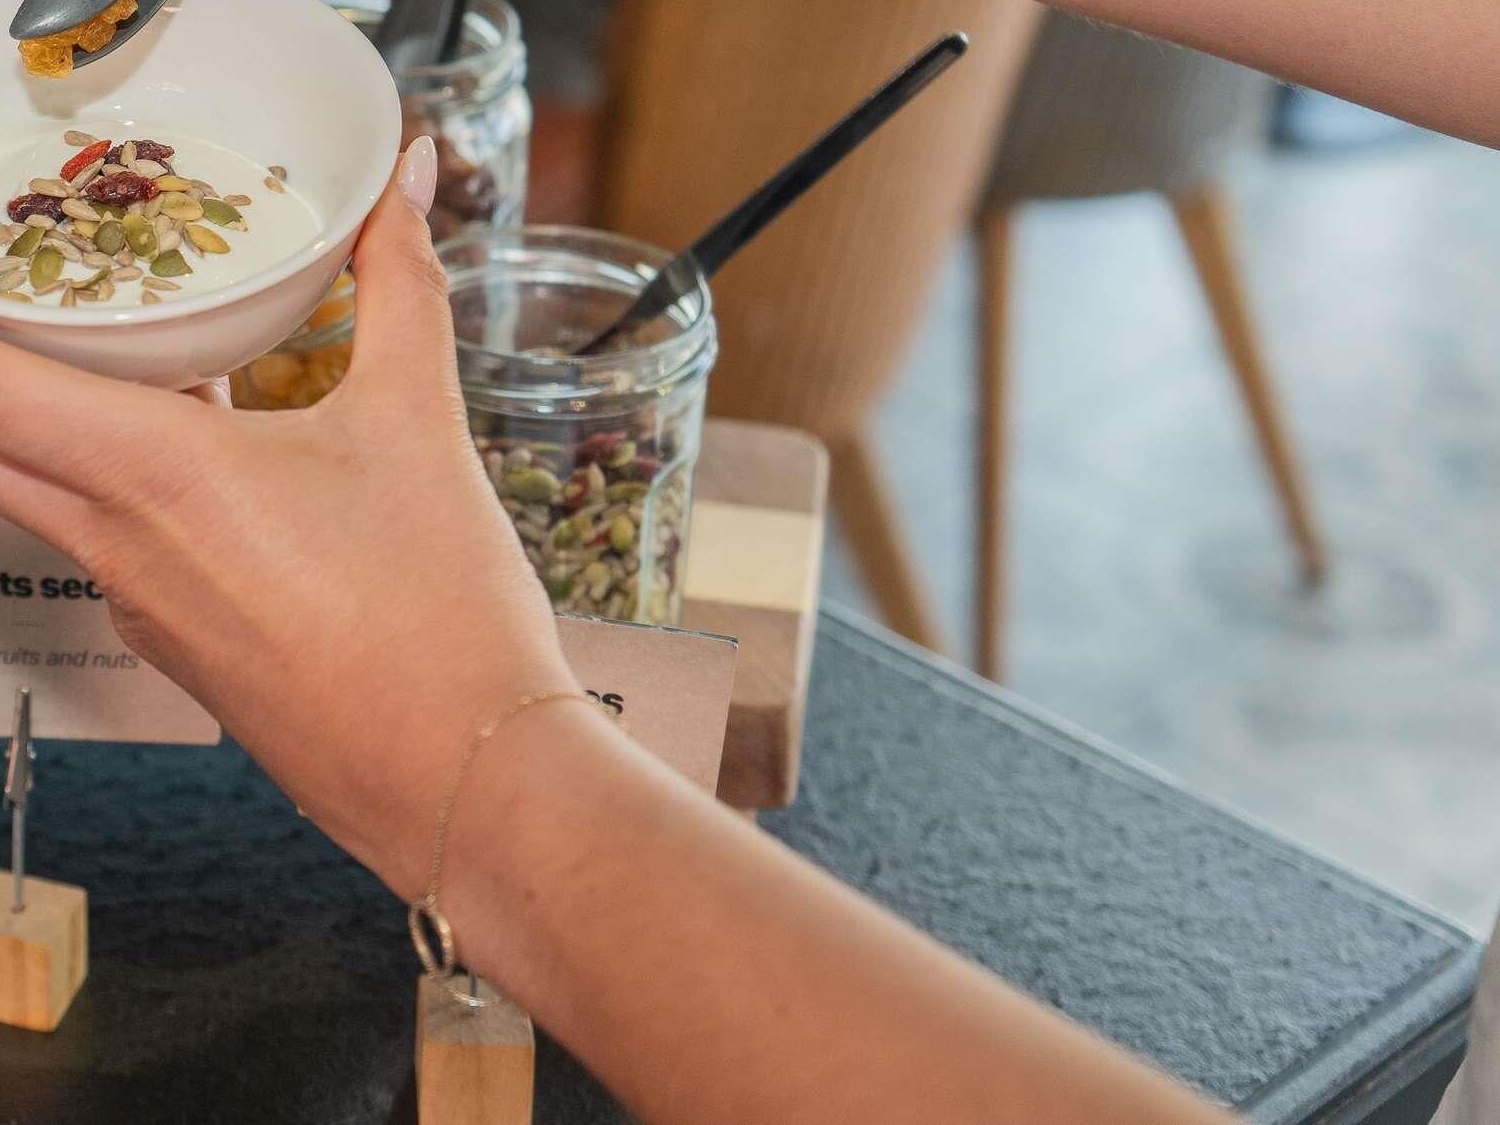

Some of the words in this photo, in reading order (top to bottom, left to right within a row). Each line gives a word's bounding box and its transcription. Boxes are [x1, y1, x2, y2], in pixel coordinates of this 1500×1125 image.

[40, 577, 105, 602] sec
[45, 648, 89, 669] and
[92, 651, 140, 671] nuts
